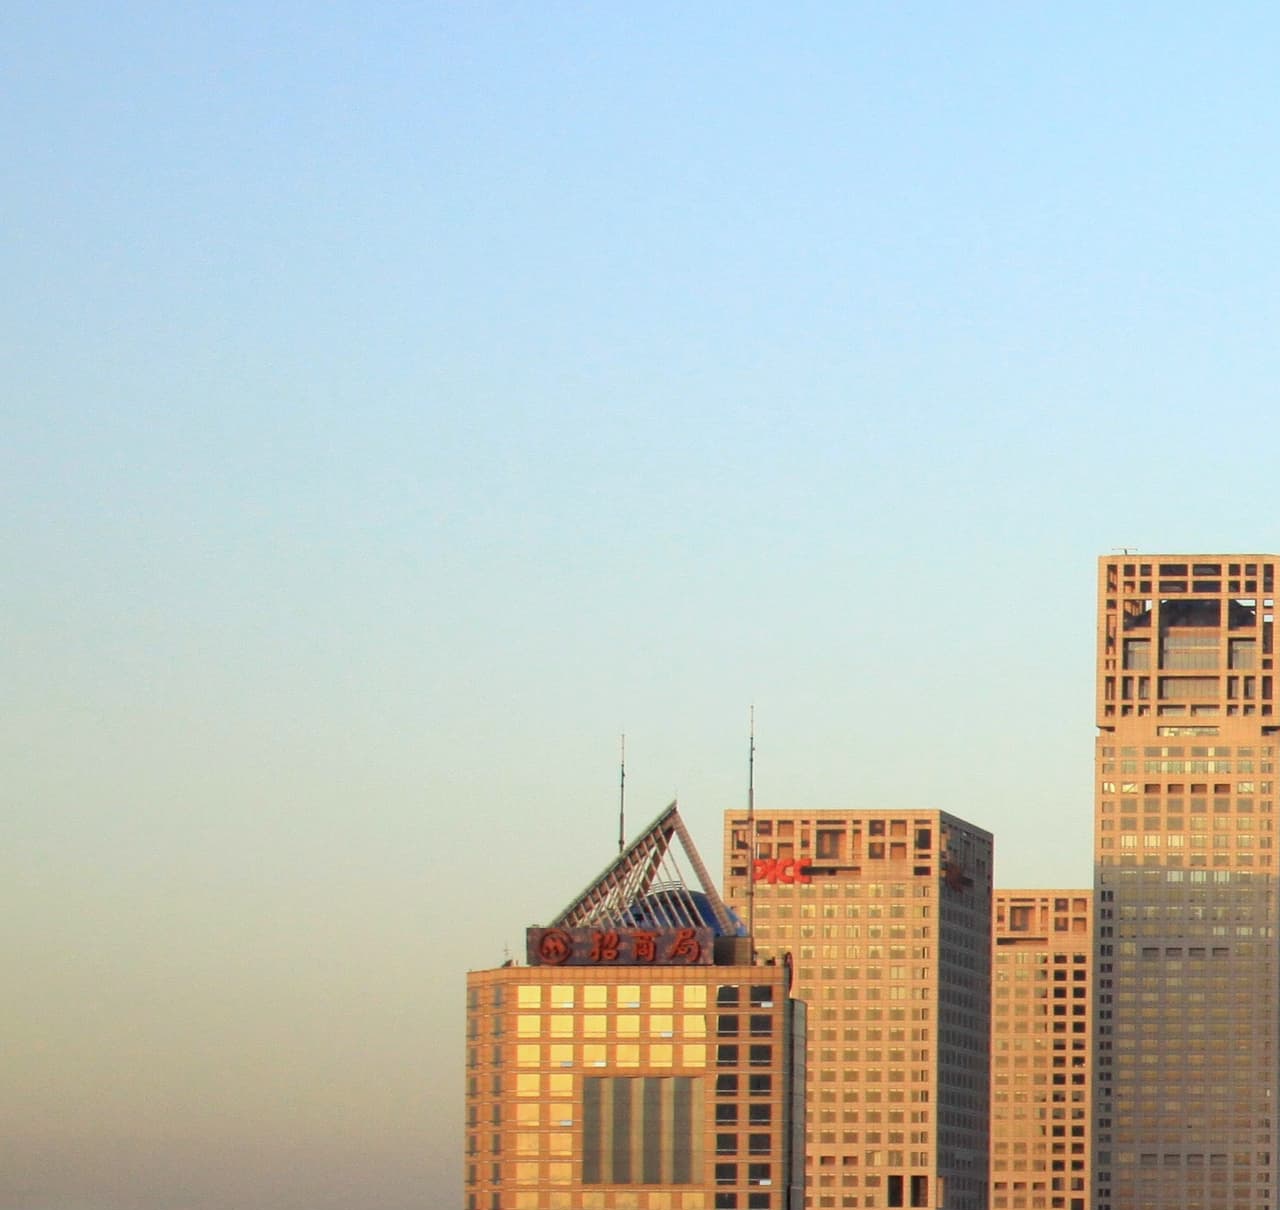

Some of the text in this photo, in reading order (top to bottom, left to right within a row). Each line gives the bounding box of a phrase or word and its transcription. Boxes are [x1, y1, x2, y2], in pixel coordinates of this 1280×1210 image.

[752, 858, 812, 884] PICC
[591, 929, 700, 962] 招商局
